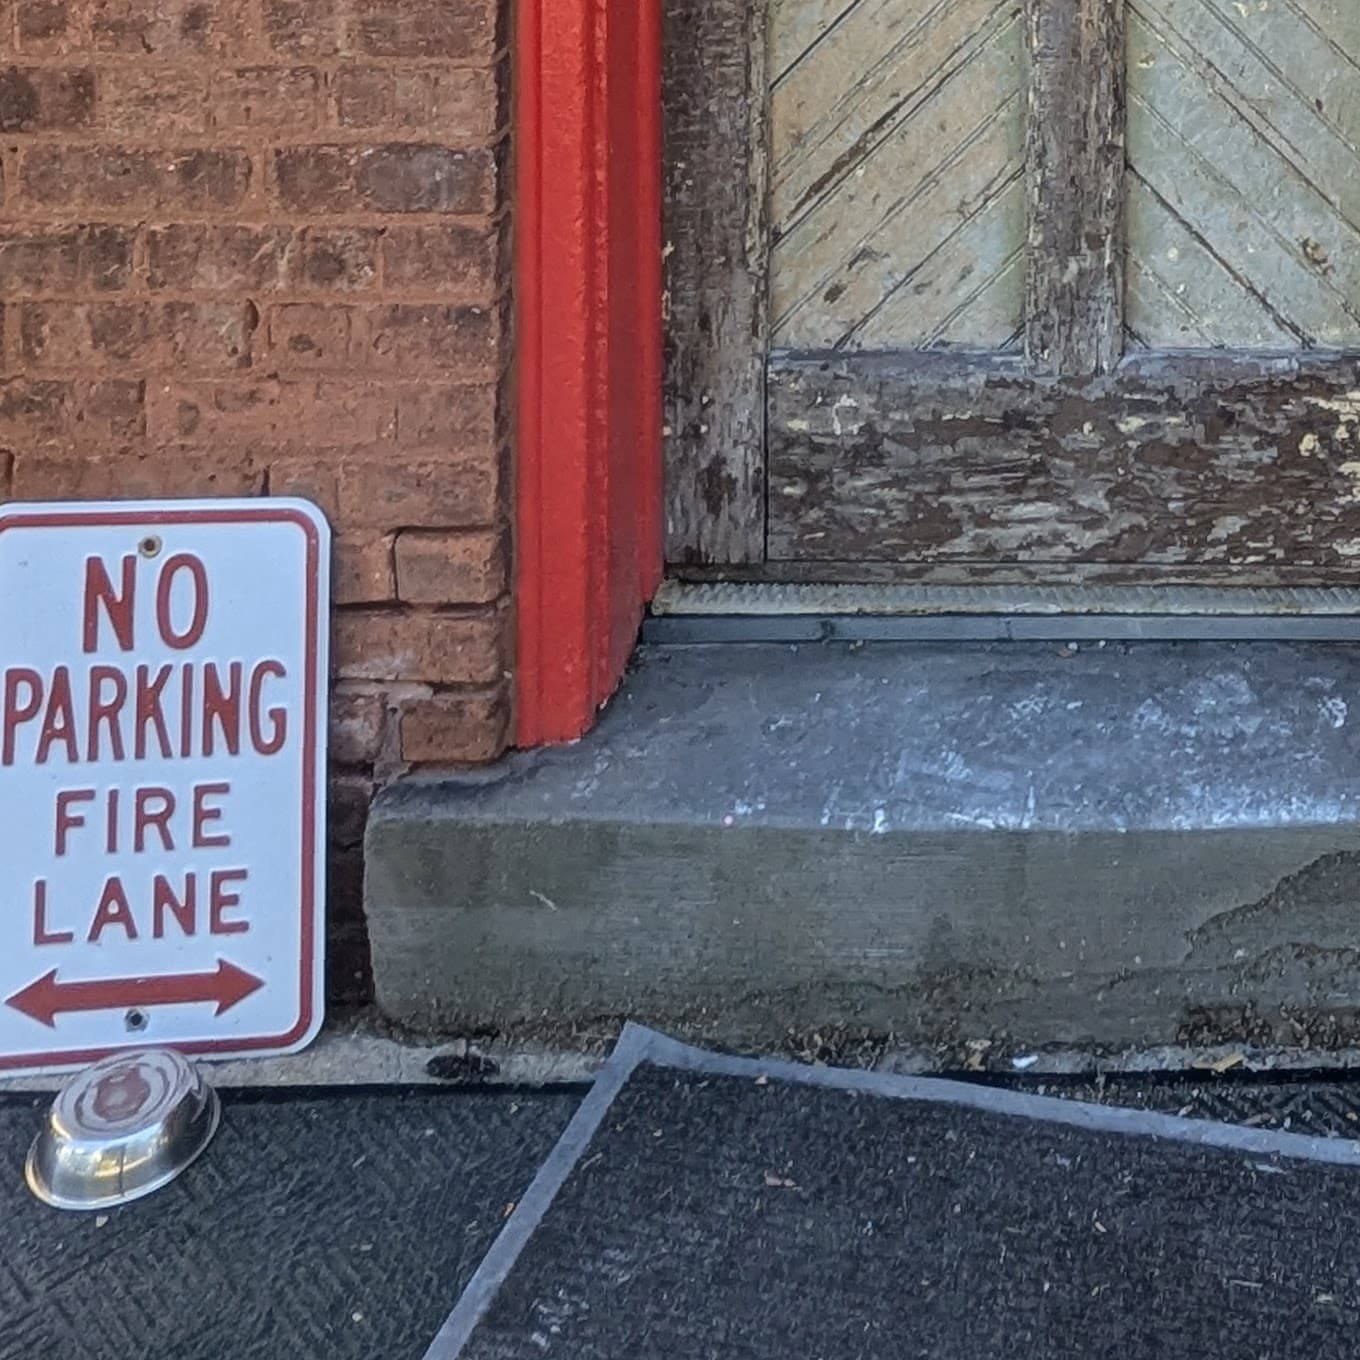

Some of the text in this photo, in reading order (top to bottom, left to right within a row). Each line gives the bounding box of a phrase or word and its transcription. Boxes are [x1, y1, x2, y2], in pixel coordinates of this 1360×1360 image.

[82, 552, 209, 654] NO
[1, 659, 288, 766] PARKING
[54, 782, 231, 857] FIRE
[33, 869, 250, 946] LANE
